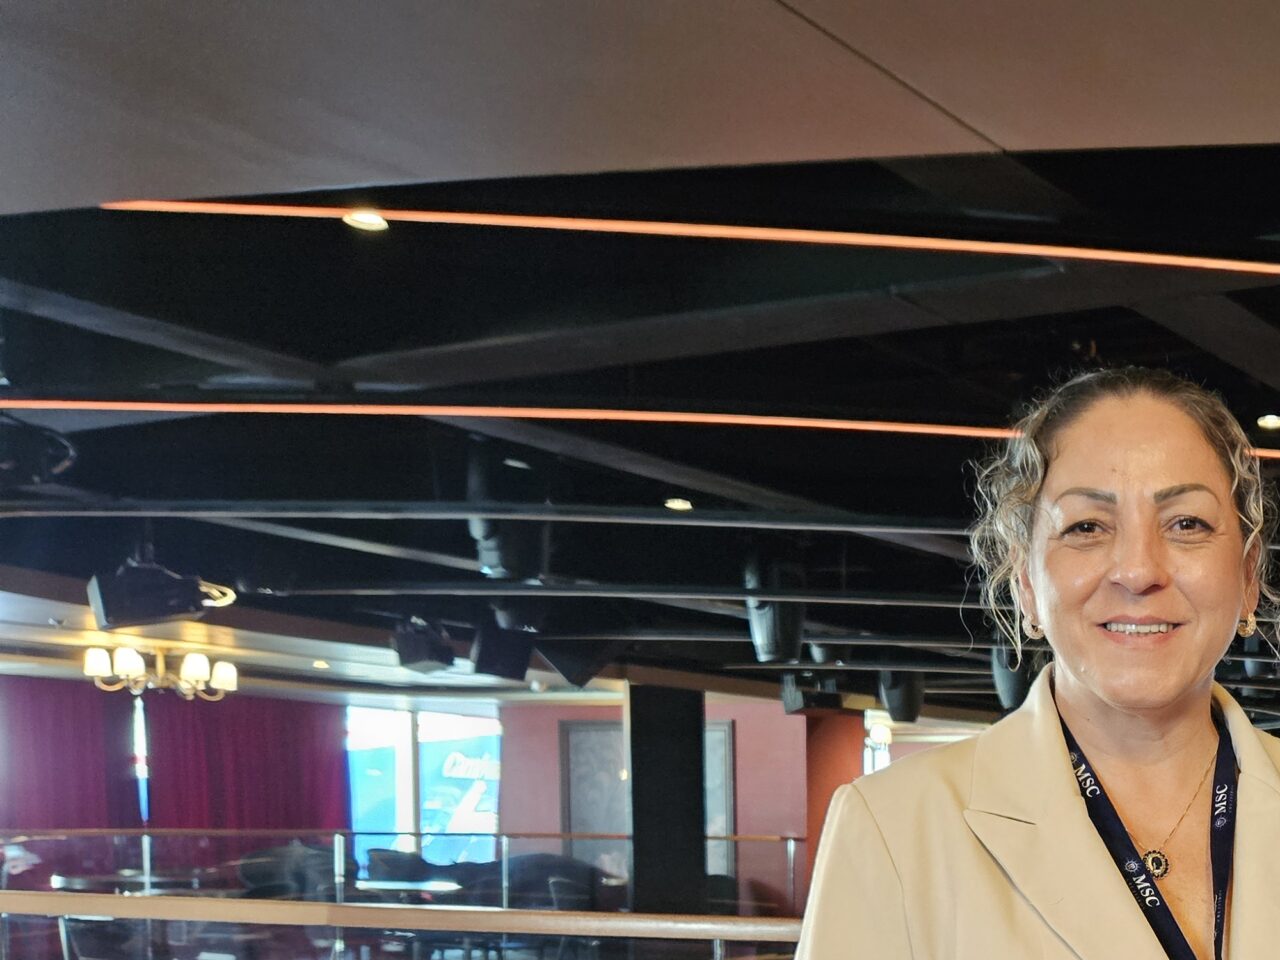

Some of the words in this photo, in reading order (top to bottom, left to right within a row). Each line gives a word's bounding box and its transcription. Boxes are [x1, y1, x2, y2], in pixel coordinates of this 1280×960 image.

[1074, 763, 1101, 798] MSC
[1214, 783, 1228, 816] MSC
[1132, 873, 1161, 908] MSC
